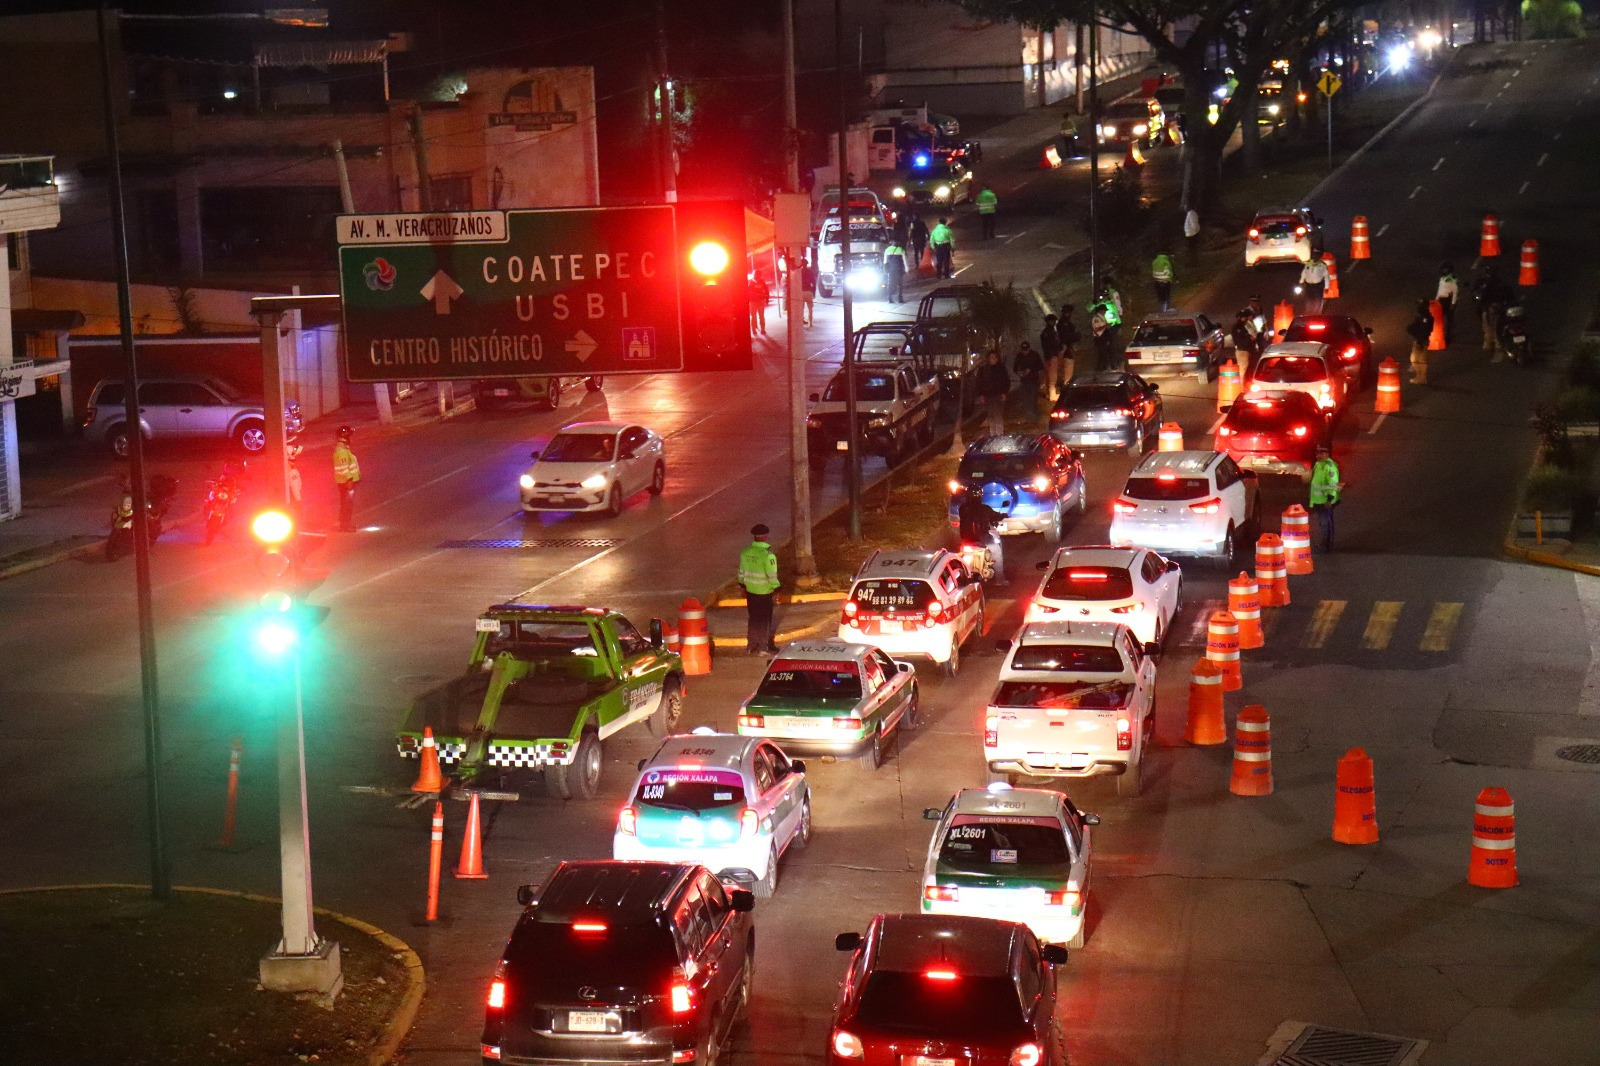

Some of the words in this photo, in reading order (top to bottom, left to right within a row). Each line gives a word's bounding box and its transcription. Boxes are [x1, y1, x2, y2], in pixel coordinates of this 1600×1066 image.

[351, 220, 370, 238] AV.
[376, 220, 390, 237] M.
[396, 216, 492, 237] VERACRUZANOS
[483, 252, 655, 284] COATEPEC
[516, 292, 628, 321] USBI
[371, 337, 440, 365] CENTRO
[451, 328, 543, 363] HISTÓRICO
[881, 559, 919, 567] 947
[857, 588, 875, 601] 947
[769, 672, 794, 681] XL-3764
[680, 748, 715, 756] XL-8349
[691, 775, 718, 783] XALAPA
